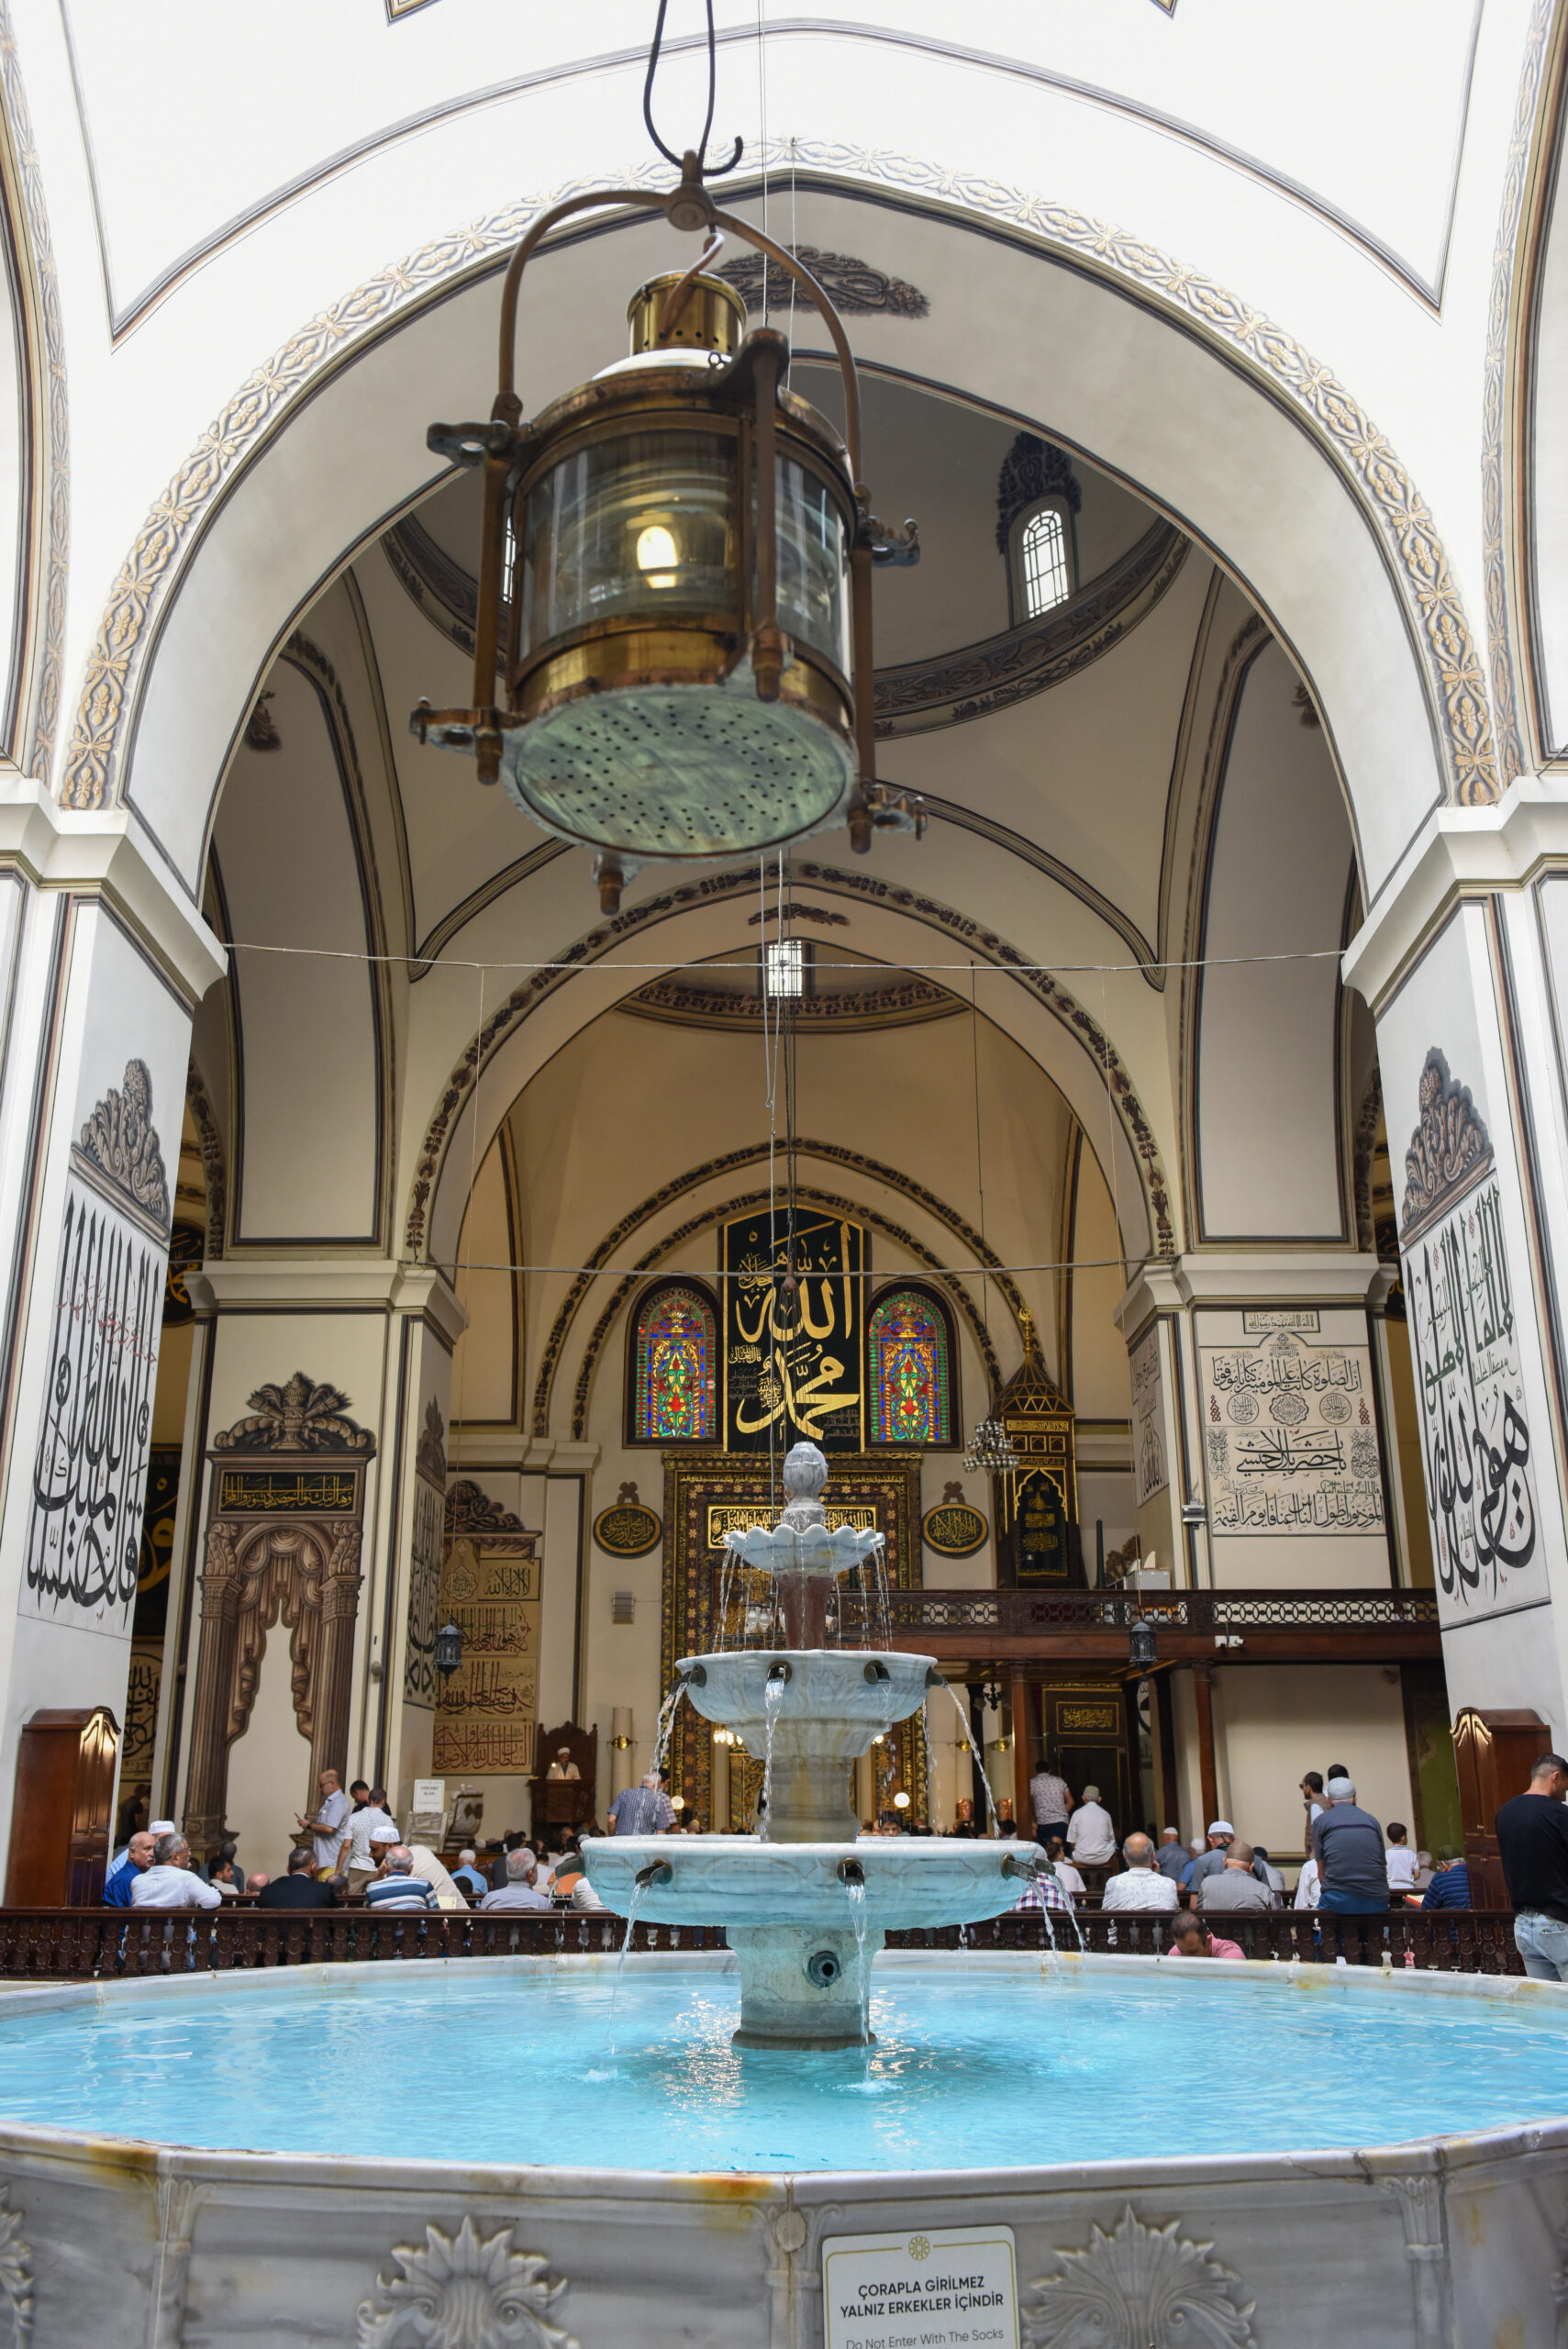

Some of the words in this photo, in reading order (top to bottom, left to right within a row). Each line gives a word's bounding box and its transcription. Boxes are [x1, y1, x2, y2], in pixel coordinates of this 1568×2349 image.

[858, 2280, 921, 2300] ÇORAPLA
[925, 2276, 984, 2292] GİRİLMEZ
[840, 2302, 885, 2318] YALNIZ
[888, 2298, 951, 2314] ERKEKLER
[955, 2291, 1004, 2311] İÇİNDİR
[846, 2340, 862, 2349] Do
[865, 2338, 885, 2349] Not
[888, 2335, 917, 2348] Enter
[919, 2332, 946, 2345] With
[949, 2331, 969, 2343] The
[972, 2329, 1004, 2341] Socks
